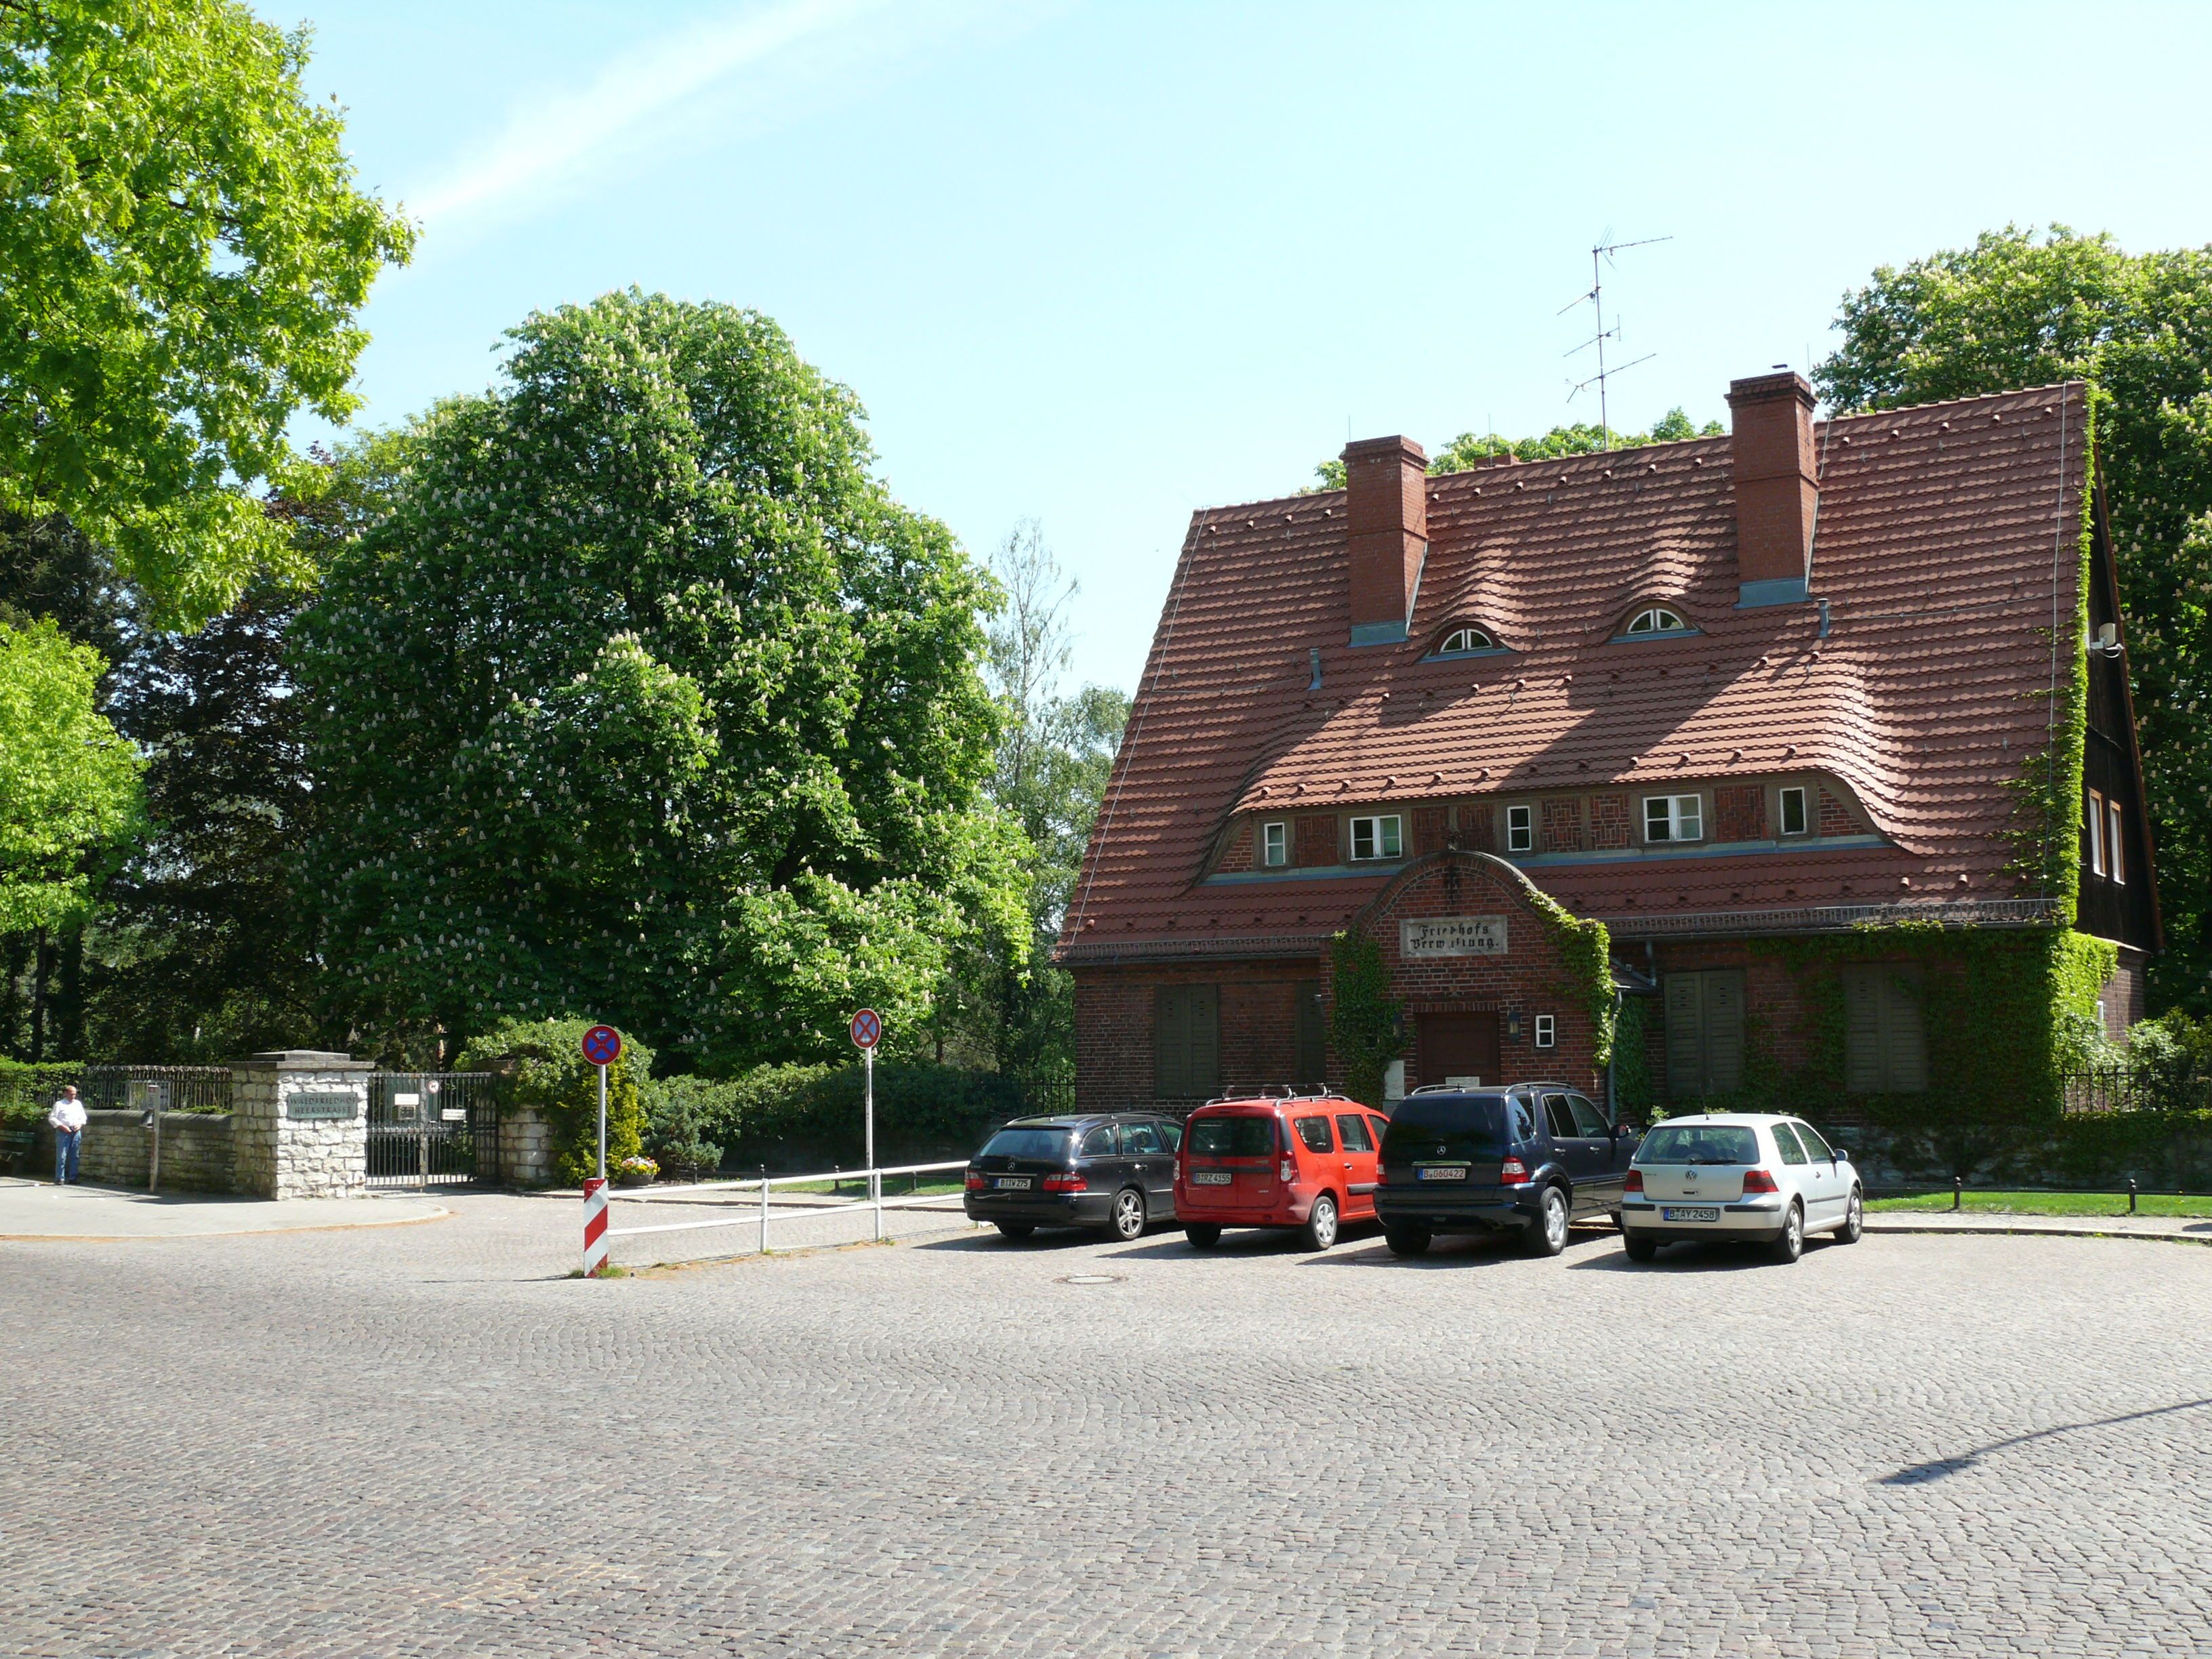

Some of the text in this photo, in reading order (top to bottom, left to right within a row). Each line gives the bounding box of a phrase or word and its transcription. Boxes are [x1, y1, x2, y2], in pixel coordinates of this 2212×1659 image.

[290, 1097, 356, 1105] WALDFRIEDHOF
[295, 1105, 352, 1115] HEERSTRASSE
[1204, 1174, 1212, 1183] RZ
[1214, 1174, 1231, 1183] 4155
[1424, 1170, 1429, 1179] B
[1000, 1179, 1006, 1187] B
[1017, 1179, 1028, 1187] 275
[1669, 1209, 1715, 1219] B AY 2458
